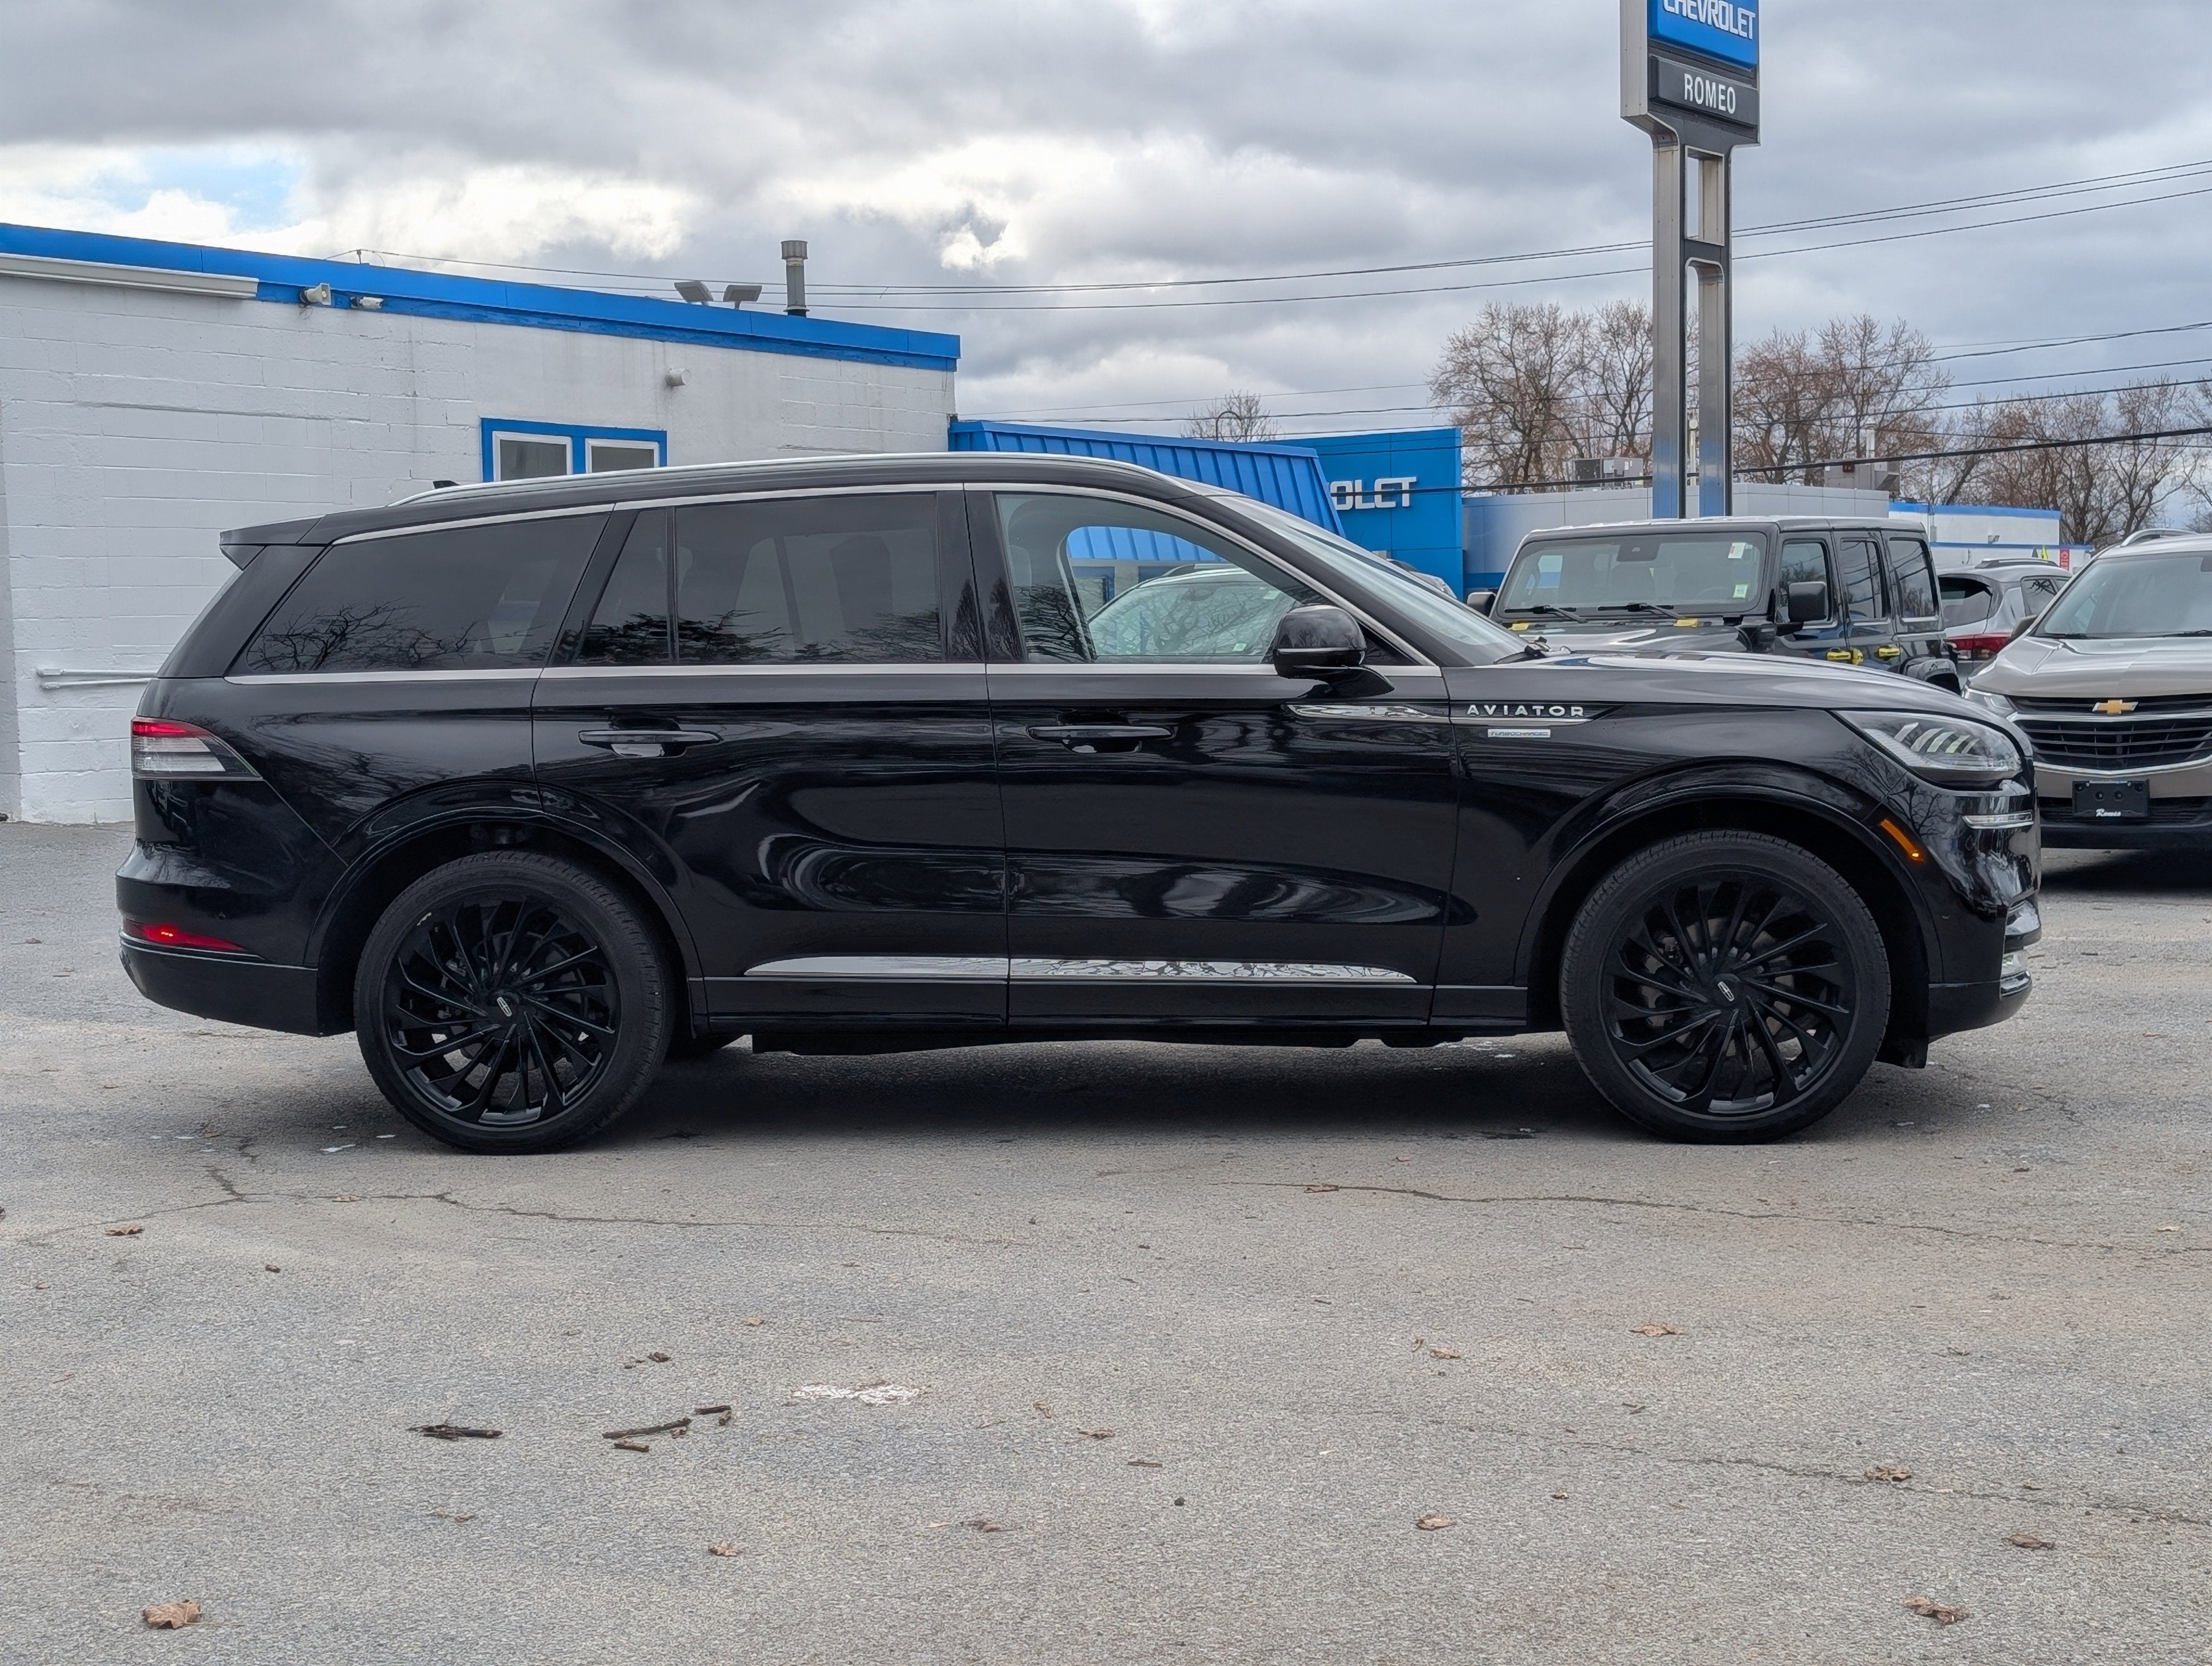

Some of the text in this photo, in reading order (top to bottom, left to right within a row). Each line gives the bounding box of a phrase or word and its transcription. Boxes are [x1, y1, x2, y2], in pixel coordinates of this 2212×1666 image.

[1684, 73, 1735, 114] ROMEO
[1327, 477, 1417, 510] OLET
[1467, 705, 1584, 716] AVIATOR
